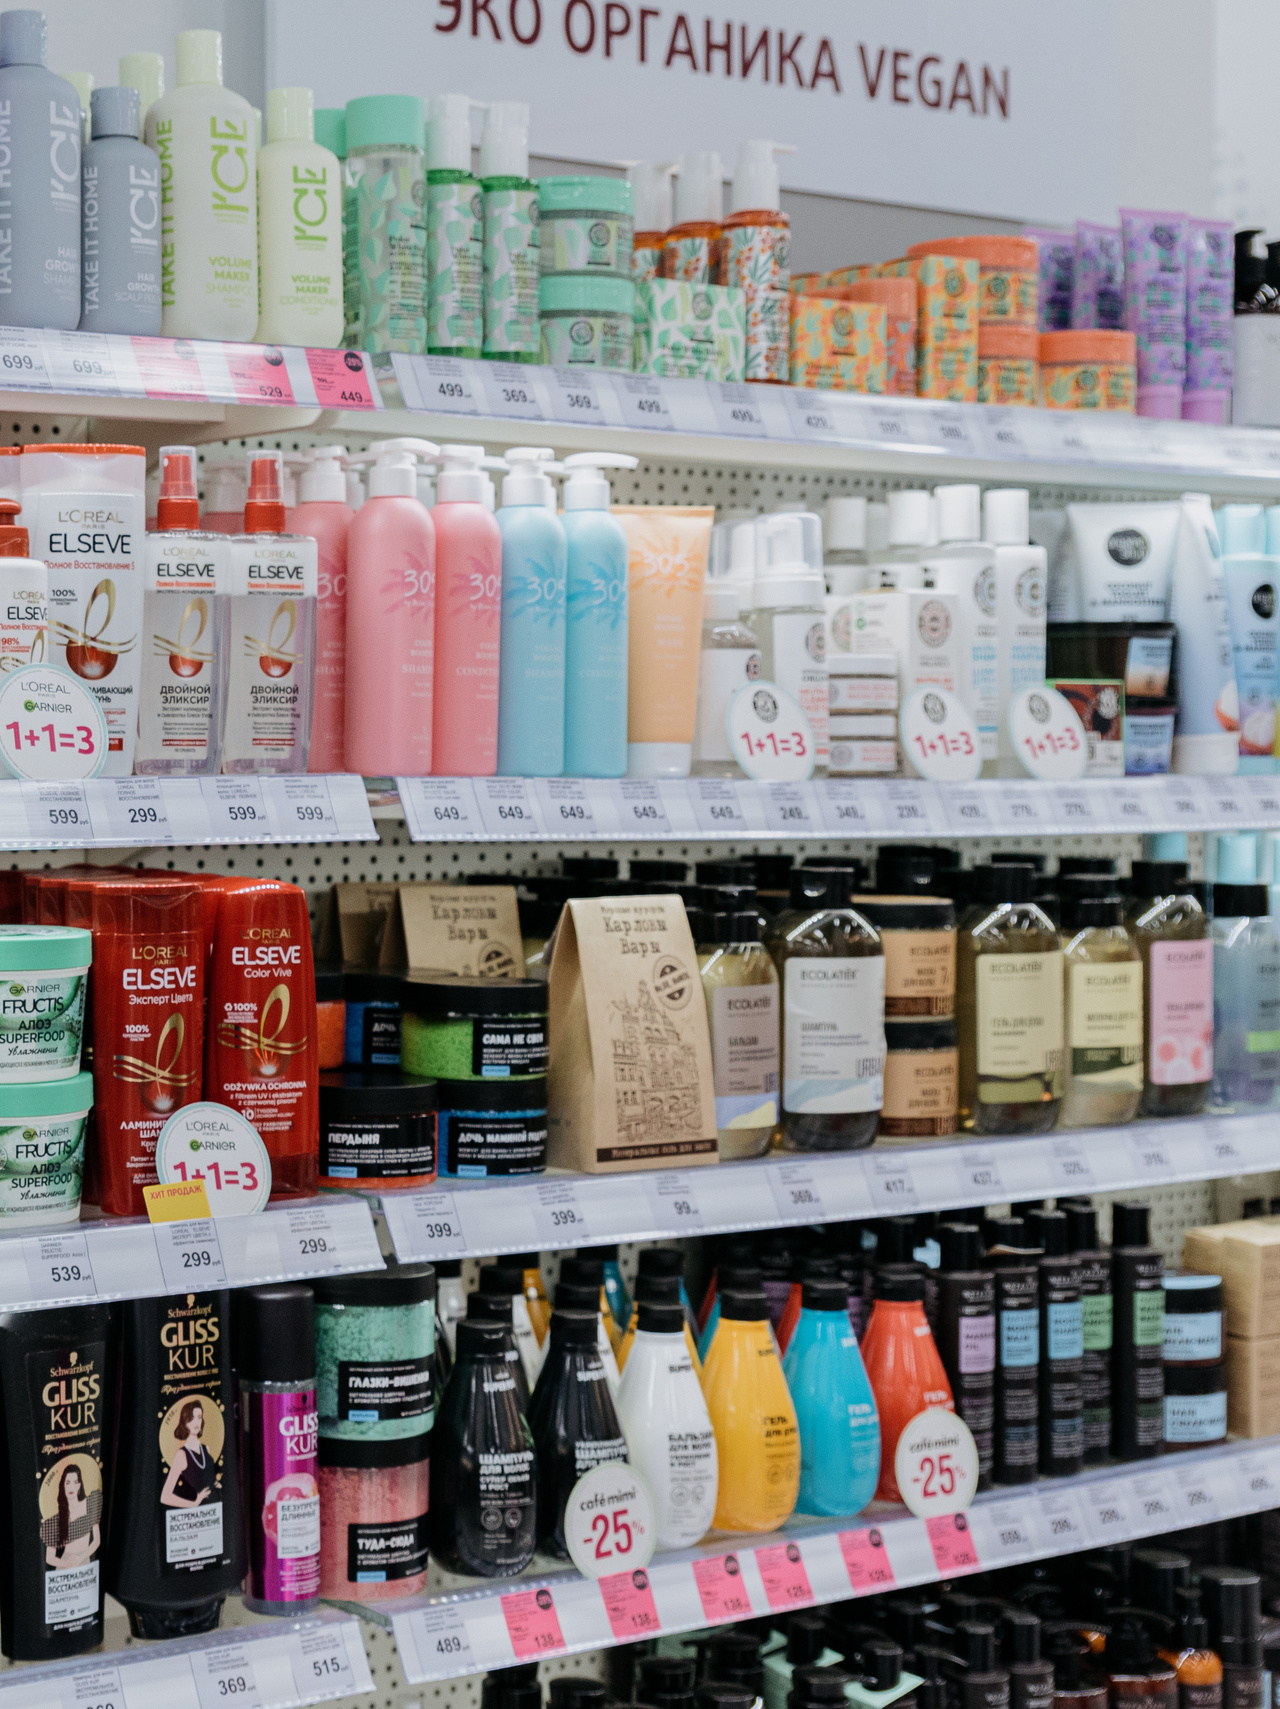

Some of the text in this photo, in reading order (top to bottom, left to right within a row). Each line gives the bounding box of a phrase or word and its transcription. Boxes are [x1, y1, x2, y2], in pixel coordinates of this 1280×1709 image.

[435, 0, 1011, 120] ЭКО ОРГАНИКА VEGAN
[292, 275, 331, 286] VOLUME
[296, 285, 329, 295] MAKER
[340, 391, 363, 403] 449
[438, 384, 464, 398] 499
[49, 533, 131, 555] ELSEVE
[157, 563, 215, 578] ELSEVE
[160, 685, 211, 697] ДВОЙНОЙ
[24, 700, 72, 714] GARNIER
[162, 695, 210, 705] ЭЛИКСИР
[6, 721, 95, 755] 1+1=3
[740, 732, 806, 758] 1+1=3
[914, 731, 975, 759] 1+1=3
[49, 808, 79, 825] 599
[128, 808, 157, 823] 299
[229, 806, 256, 821] 599
[434, 805, 460, 821] 649
[232, 945, 301, 966] ELSEVE
[122, 966, 196, 990] ELSEVE
[244, 967, 292, 979] Color Vive
[2, 997, 64, 1015] FRUCTIS
[128, 992, 194, 1006] Эксперт Цвета
[18, 1018, 52, 1031] АЛОЭ
[0, 1030, 65, 1045] SUPERFOOD
[328, 1132, 381, 1146] ПЕРДЫНЯ
[150, 1184, 203, 1200] ХИТ ПРОДАЖ
[181, 1250, 211, 1268] 299
[51, 1265, 81, 1283] 539
[167, 1304, 212, 1320] Schwarzkopf
[160, 1317, 219, 1348] GLISS
[168, 1345, 215, 1372] KUR
[580, 1490, 638, 1512] café mimi
[357, 1534, 414, 1551] ТУДА-СЮДА
[48, 1568, 95, 1585] ЭКСТРЕМАЛЬНОЕ
[48, 1576, 98, 1594] ВОССТАНОВЛЕНИЕ
[436, 1636, 461, 1654] 489
[313, 1658, 340, 1677] 515
[218, 1677, 247, 1695] 369
